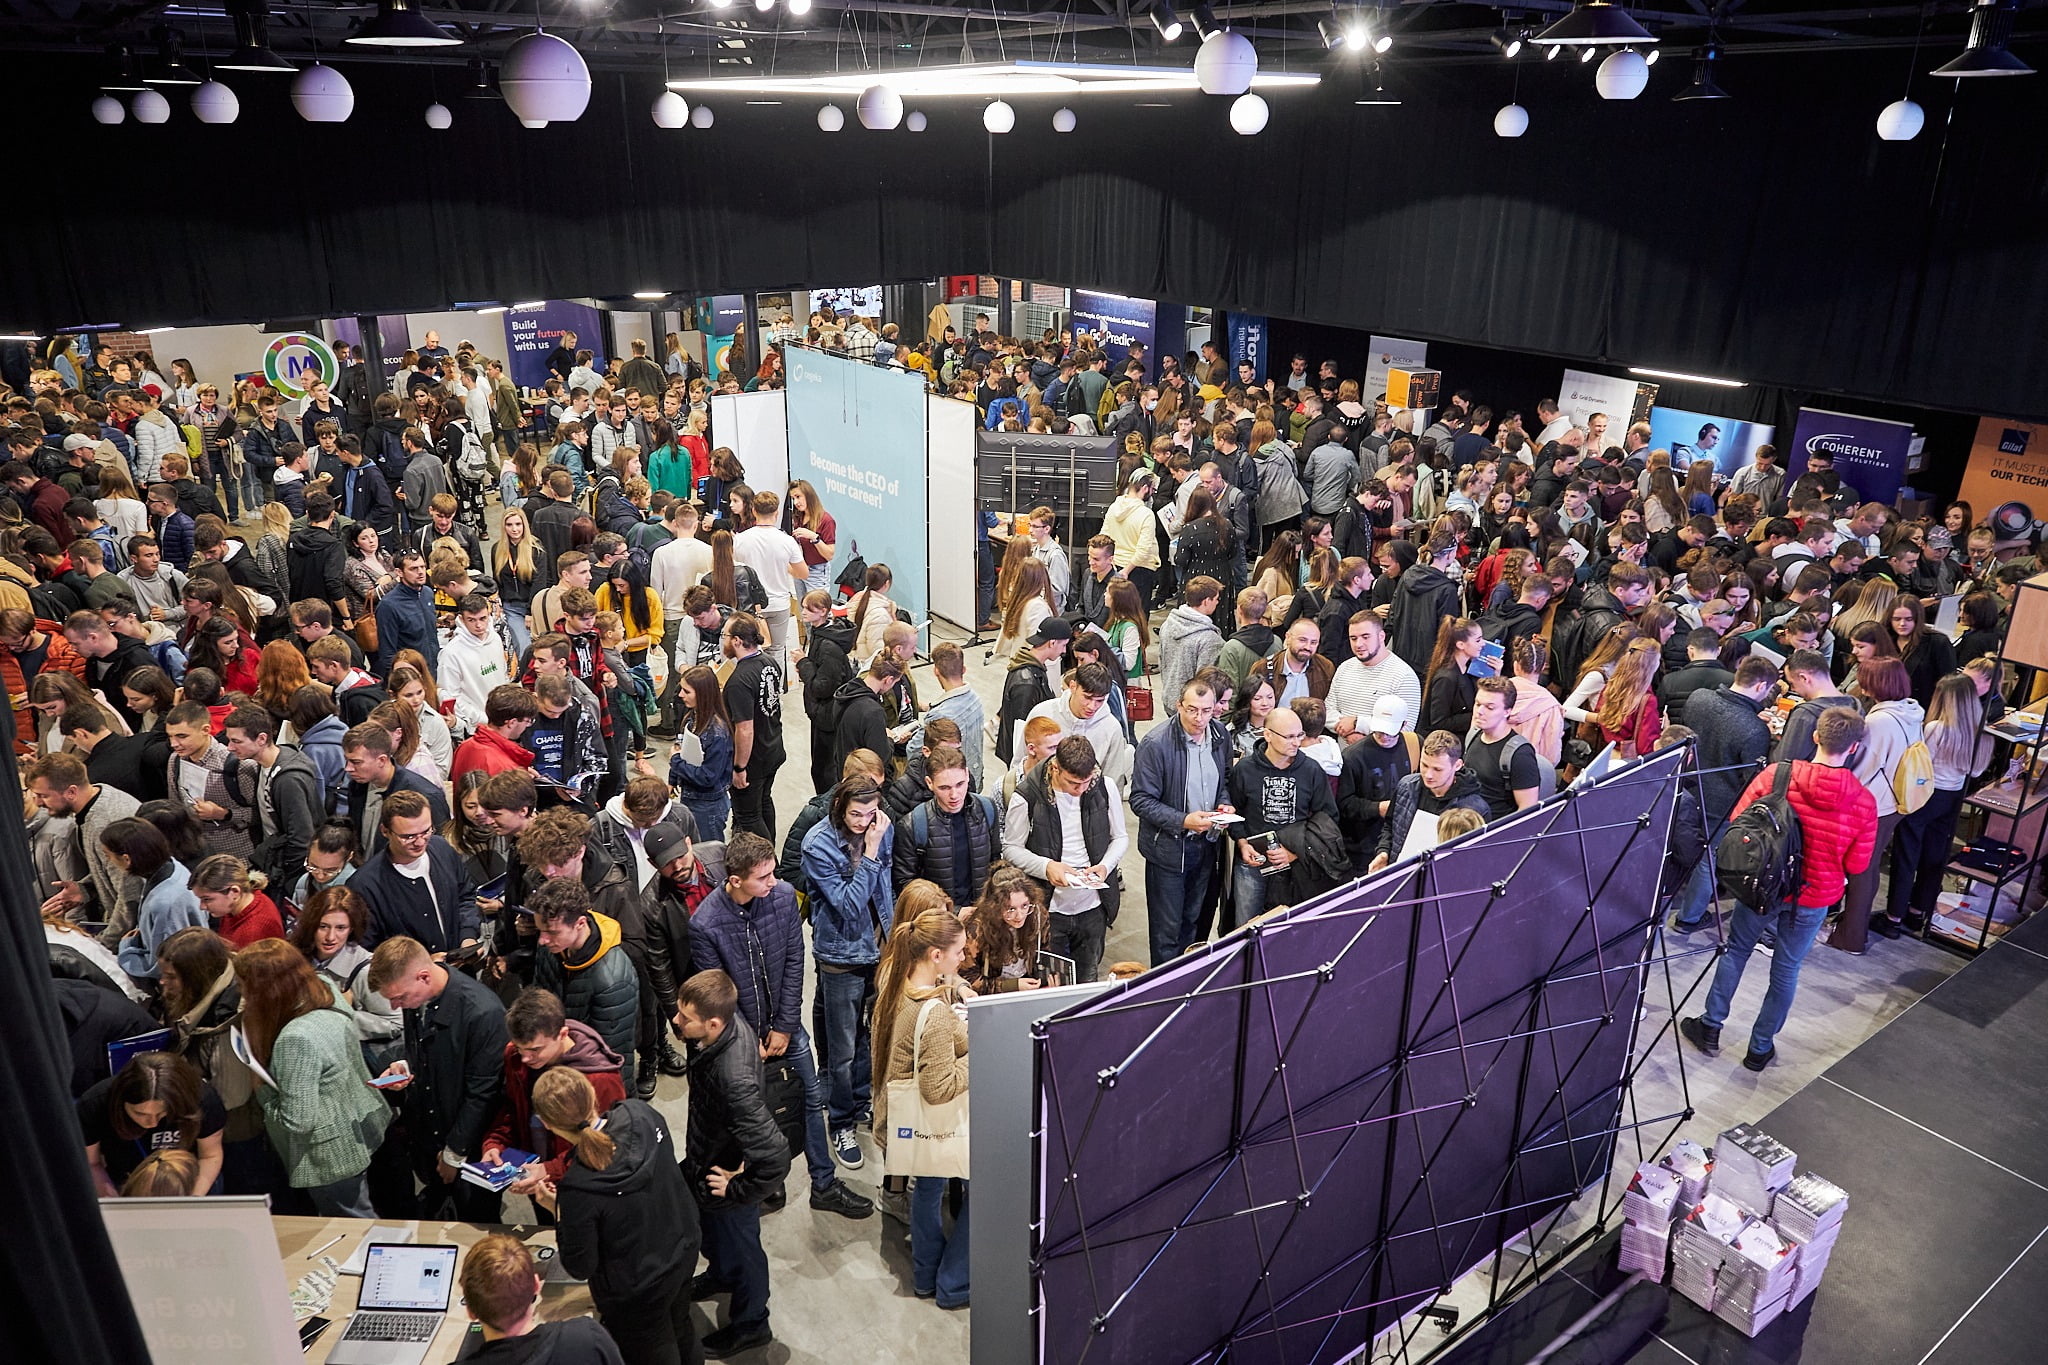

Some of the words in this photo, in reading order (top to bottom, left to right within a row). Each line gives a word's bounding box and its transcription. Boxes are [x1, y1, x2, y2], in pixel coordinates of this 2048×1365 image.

[511, 320, 537, 331] Build
[513, 332, 536, 343] your
[537, 330, 567, 339] future
[1089, 328, 1136, 347] GoPredict
[515, 341, 536, 352] with
[538, 341, 550, 349] us
[1821, 441, 1883, 460] COHERENT
[2001, 441, 2023, 453] Gilat
[1850, 457, 1890, 468] SOLUTIONS
[1993, 458, 2004, 467] IT
[2005, 459, 2037, 473] MUST
[809, 450, 847, 477] Become
[848, 464, 864, 484] the
[865, 470, 887, 492] CEO
[887, 479, 900, 497] of
[1990, 469, 2013, 481] OUR
[824, 477, 847, 494] your
[848, 485, 883, 509] career!
[151, 1130, 181, 1143] EBS
[900, 1129, 910, 1137] GP
[914, 1130, 956, 1141] GovPredict
